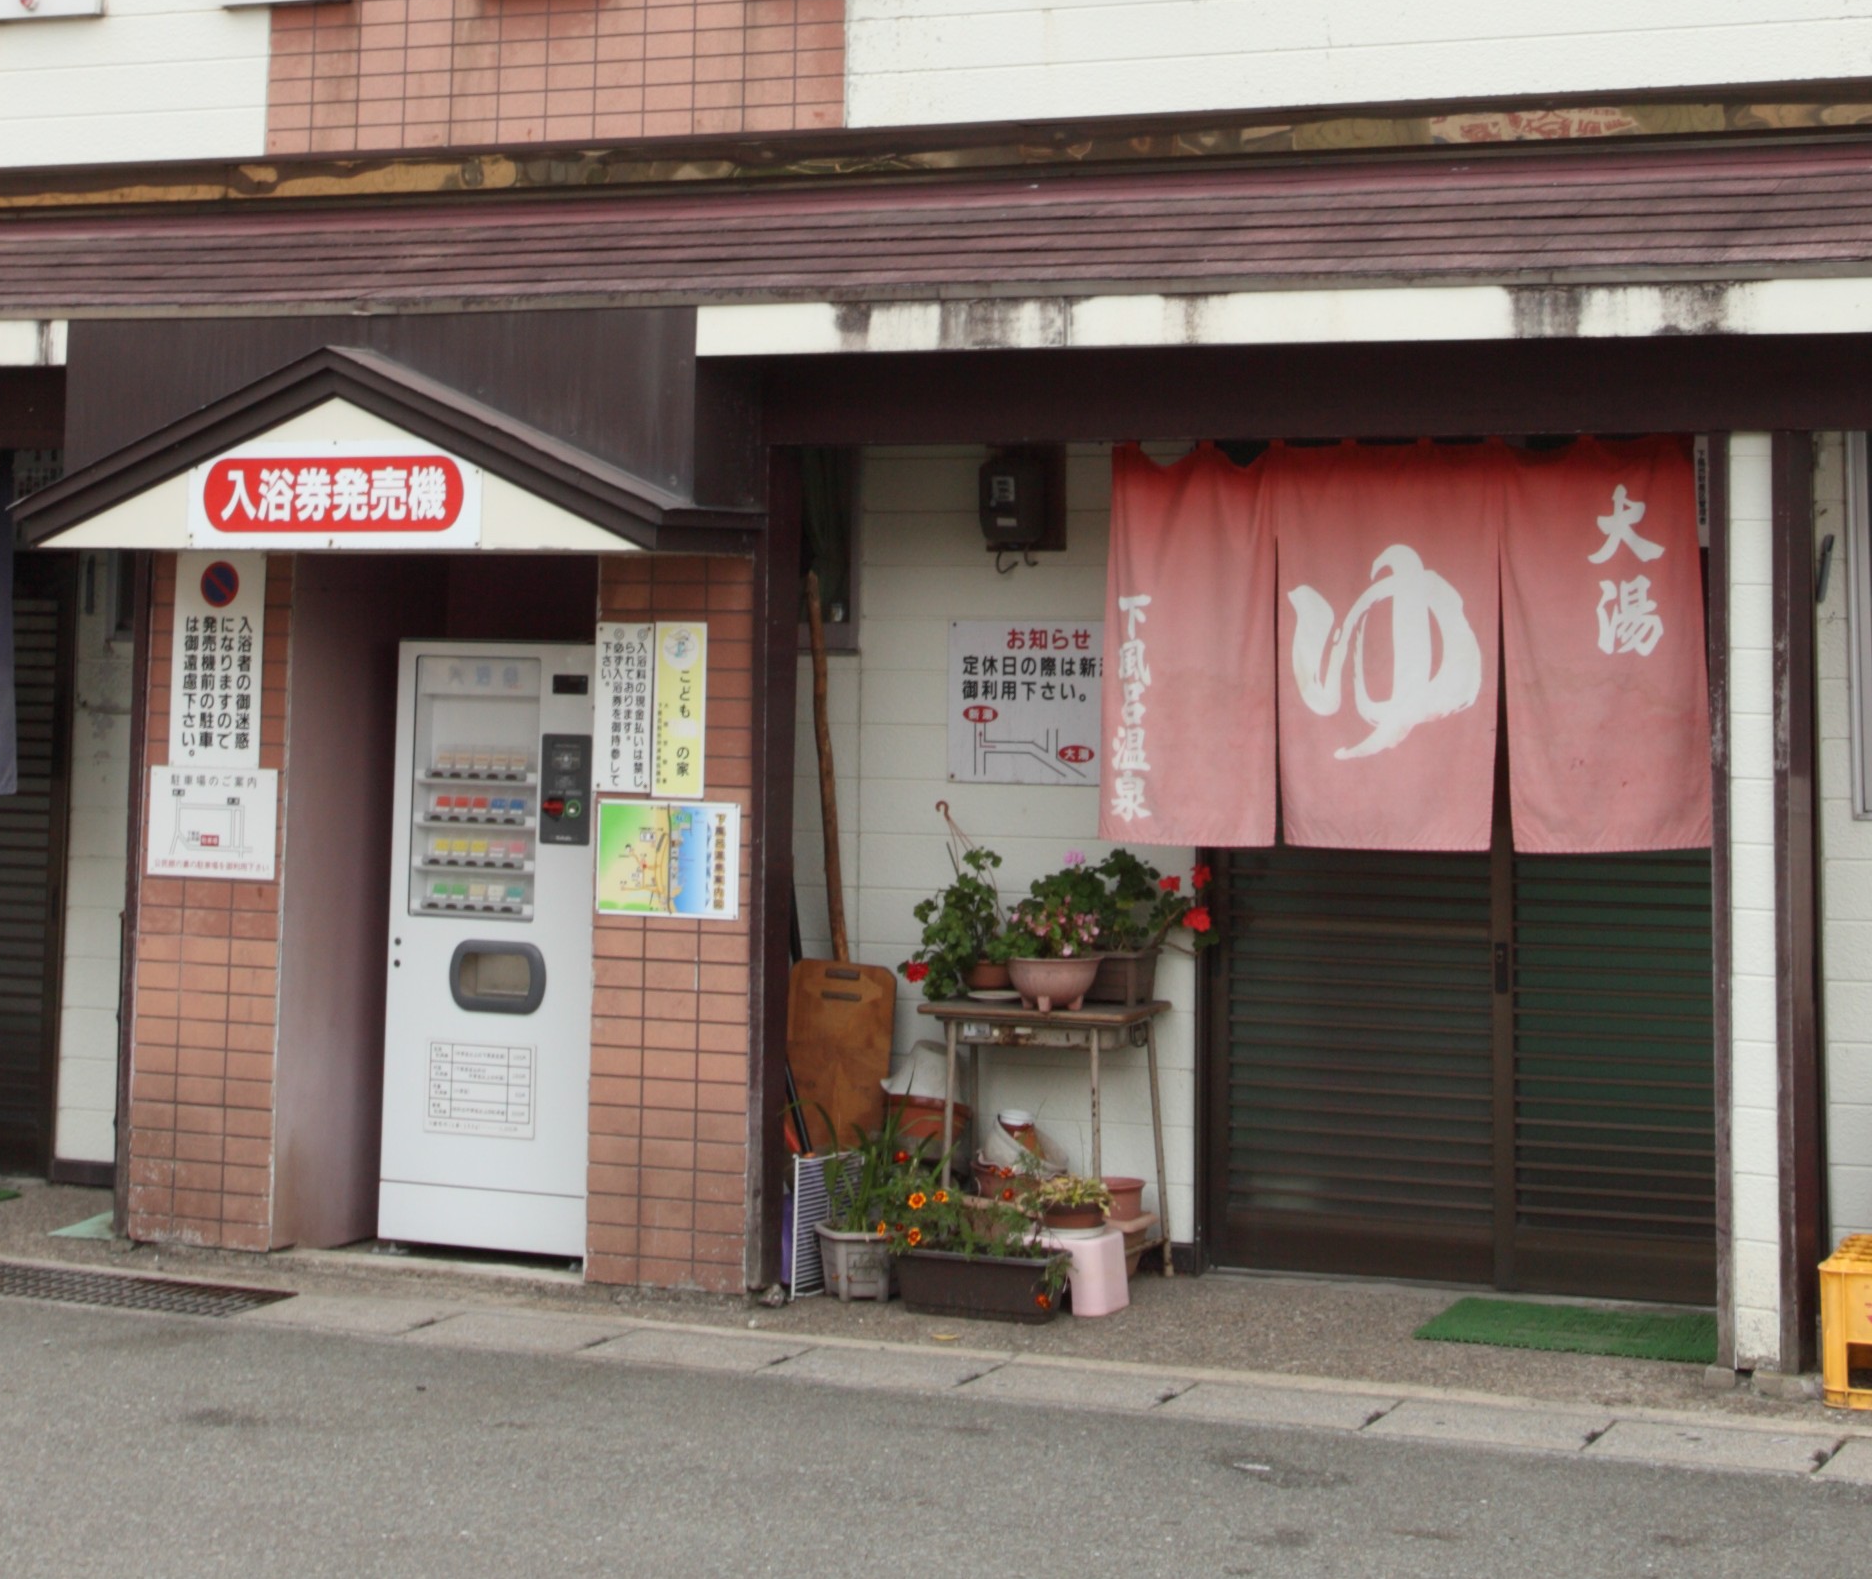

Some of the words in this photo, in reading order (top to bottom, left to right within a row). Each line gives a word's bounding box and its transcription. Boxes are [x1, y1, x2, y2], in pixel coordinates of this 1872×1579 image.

[220, 467, 446, 523] 入浴券発売機
[1588, 485, 1665, 656] 大湯
[182, 615, 199, 758] は御遠慮下さい。
[199, 616, 217, 748] 発売機前の駐車
[217, 616, 235, 750] になりますので
[235, 616, 253, 750] 入浴者の御迷惑
[601, 641, 612, 687] 下さい。
[962, 655, 1103, 678] 定休日の際は新
[1006, 628, 1091, 651] お知らせ
[1287, 543, 1483, 760] ゆ
[678, 670, 691, 718] こども
[962, 680, 1087, 703] 御利用下さい。
[1111, 593, 1152, 821] 下風呂温泉
[676, 746, 690, 777] の家
